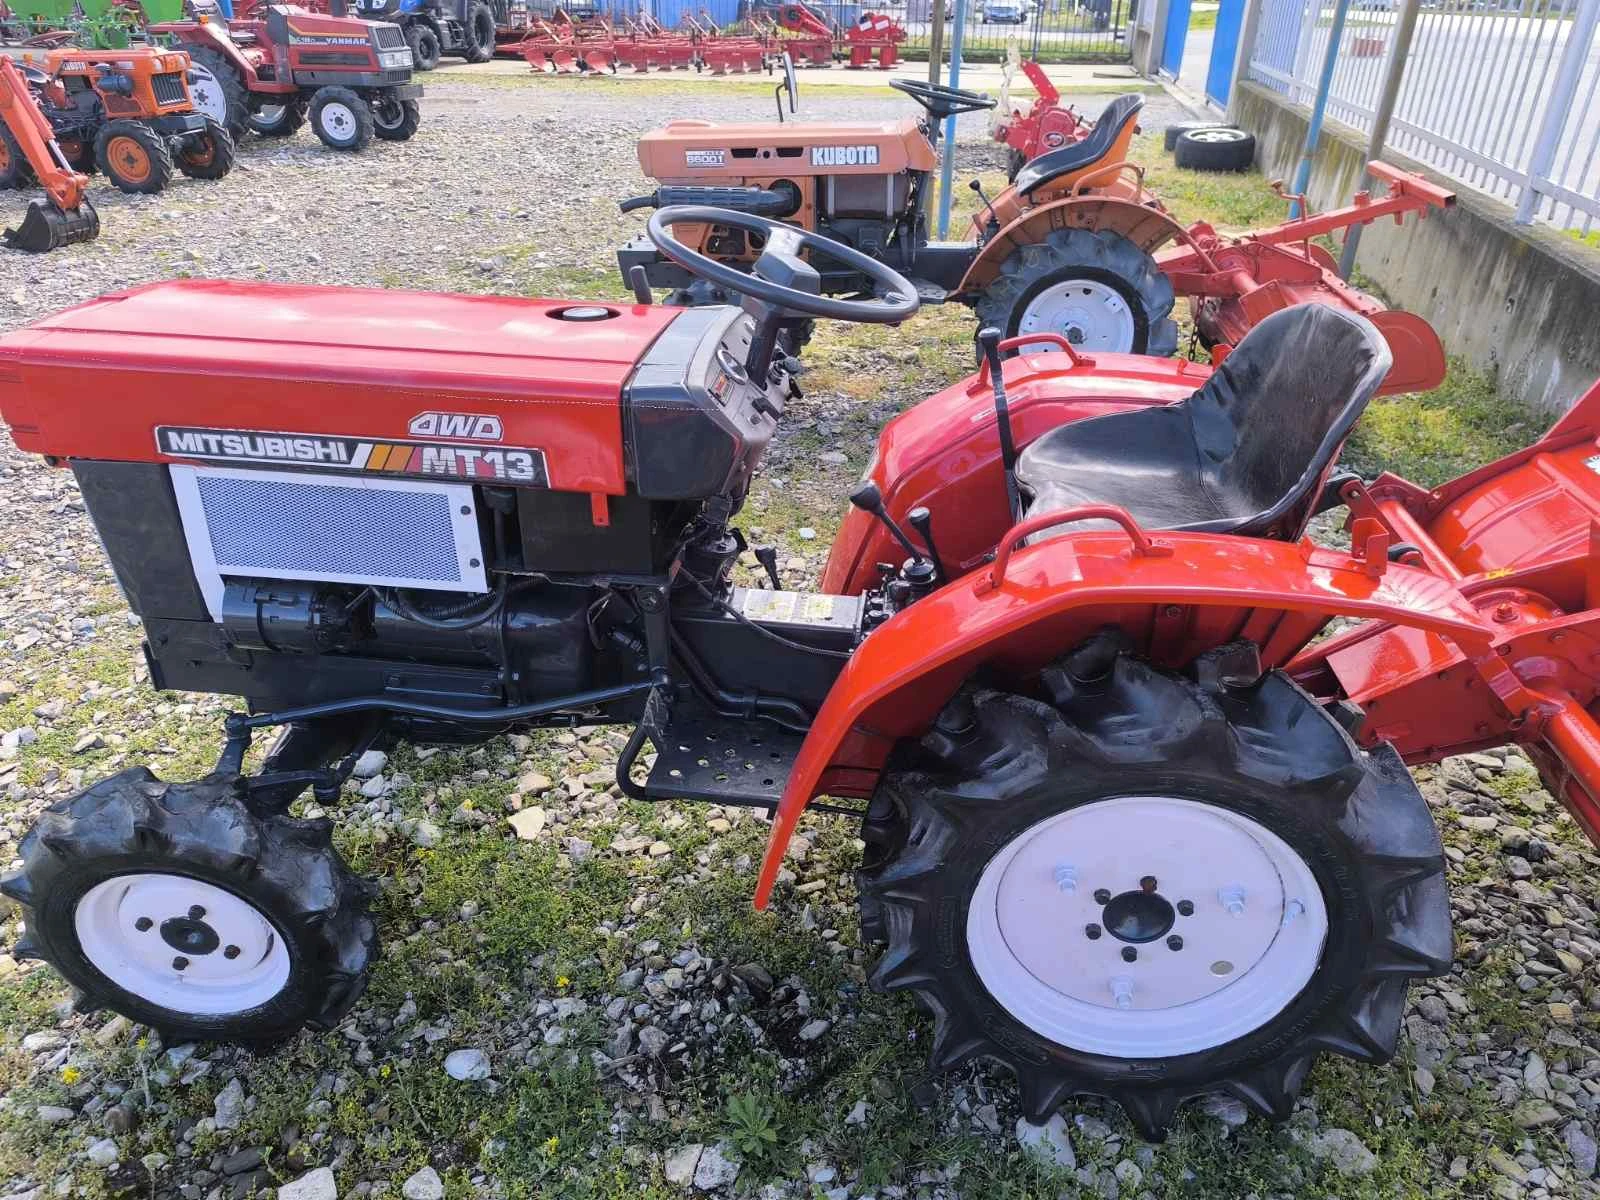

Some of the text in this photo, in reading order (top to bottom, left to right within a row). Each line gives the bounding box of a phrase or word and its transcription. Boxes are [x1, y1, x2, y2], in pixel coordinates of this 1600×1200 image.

[326, 37, 366, 45] YANMAR
[812, 146, 878, 165] KUBOTA
[409, 413, 502, 440] 4WD
[167, 431, 534, 480] MITSUBISHI MT13
